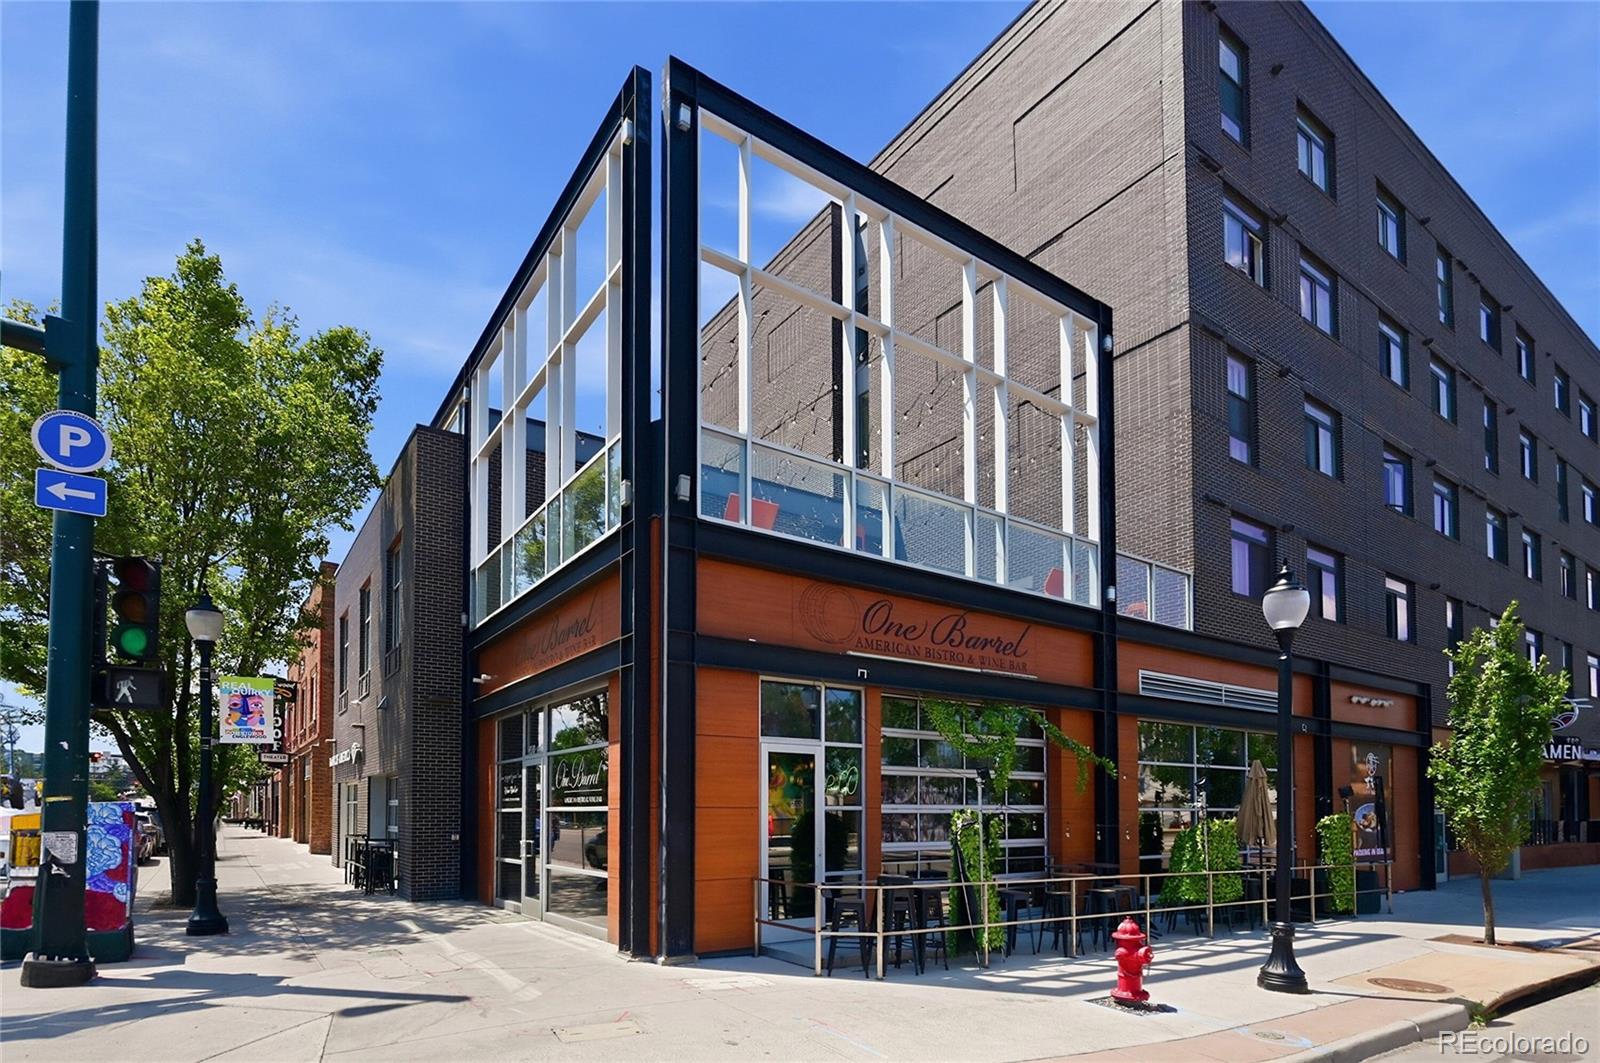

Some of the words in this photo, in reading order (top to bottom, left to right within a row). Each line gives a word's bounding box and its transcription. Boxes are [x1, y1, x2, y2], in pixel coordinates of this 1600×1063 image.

[59, 424, 92, 457] P
[541, 587, 600, 654] Barrel
[862, 600, 928, 641] One
[930, 610, 1029, 658] Barrel
[855, 636, 921, 657] AMERICAN
[924, 647, 965, 662] BISTRO
[967, 655, 976, 665] &
[979, 655, 1007, 669] WINE
[1008, 660, 1029, 673] BAR
[231, 688, 271, 696] QUIRKY
[1541, 744, 1582, 760] AMEN
[568, 754, 603, 789] Barrel
